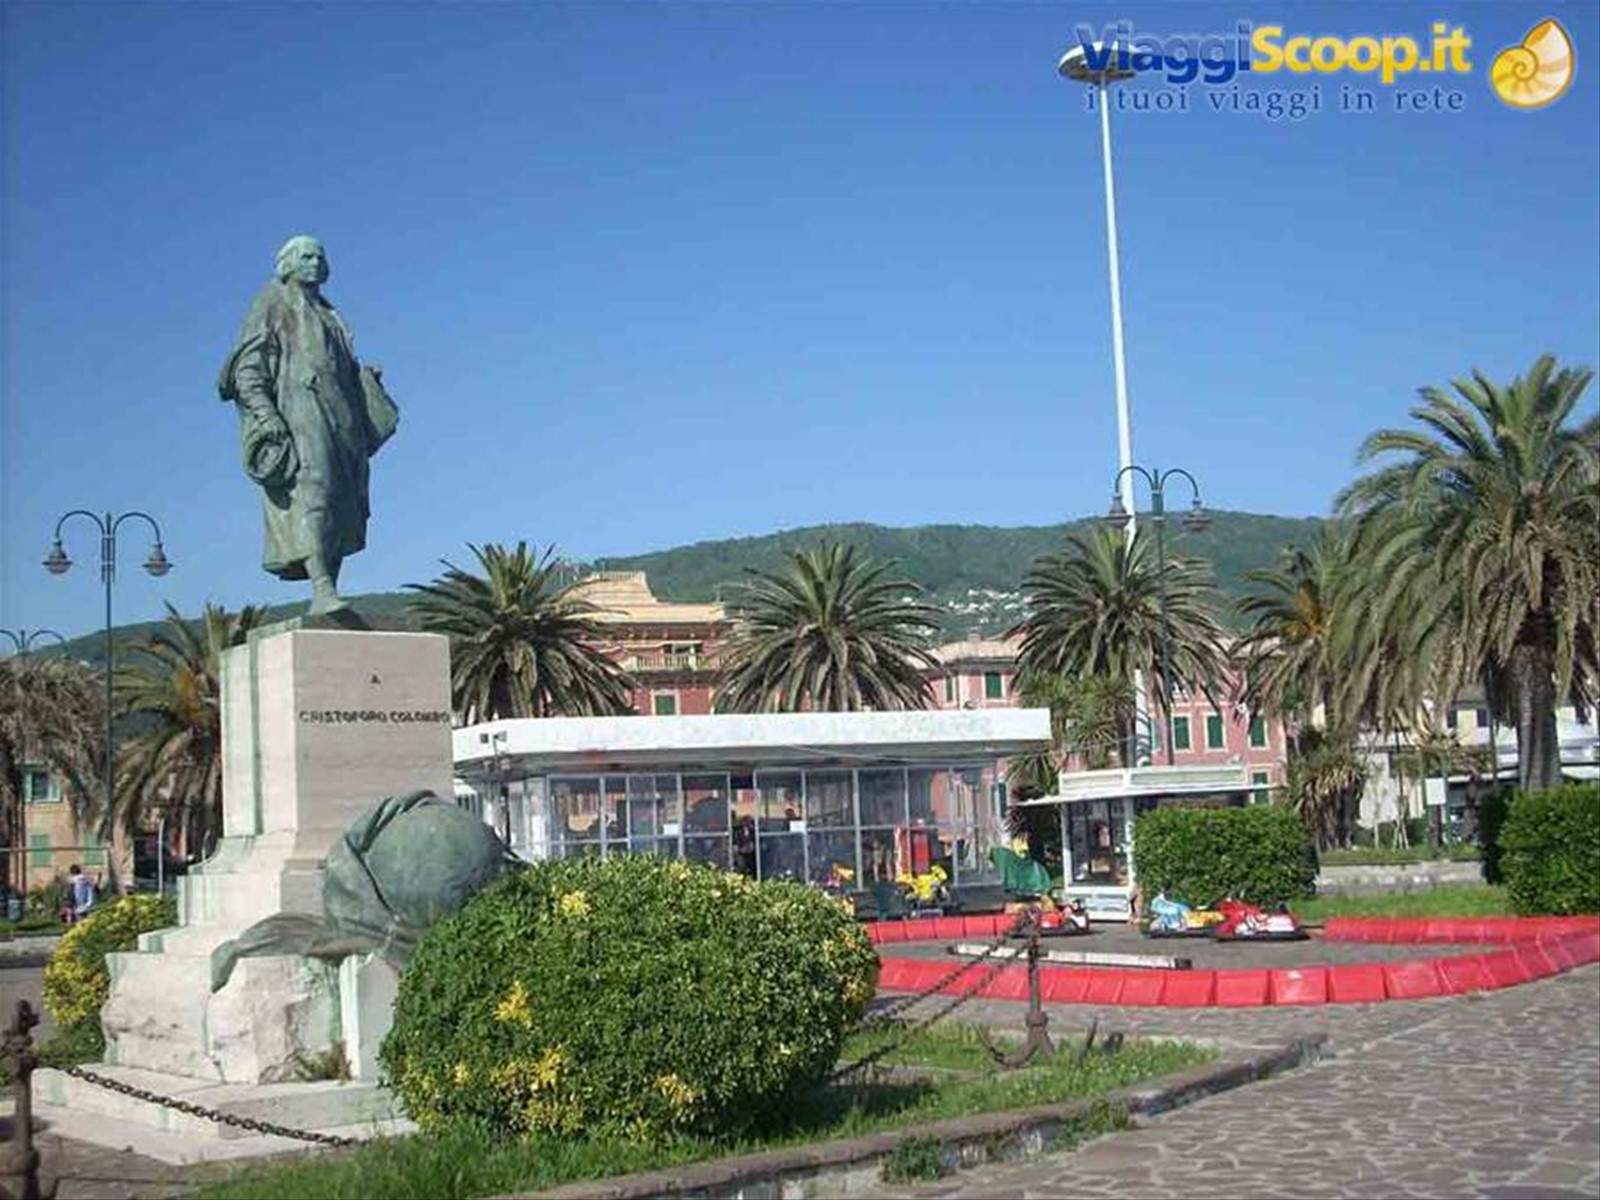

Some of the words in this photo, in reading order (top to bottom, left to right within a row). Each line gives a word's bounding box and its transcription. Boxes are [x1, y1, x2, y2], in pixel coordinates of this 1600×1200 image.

[370, 673, 381, 685] A
[299, 710, 387, 723] CRISTOFORO
[389, 710, 450, 723] COLOMBO
